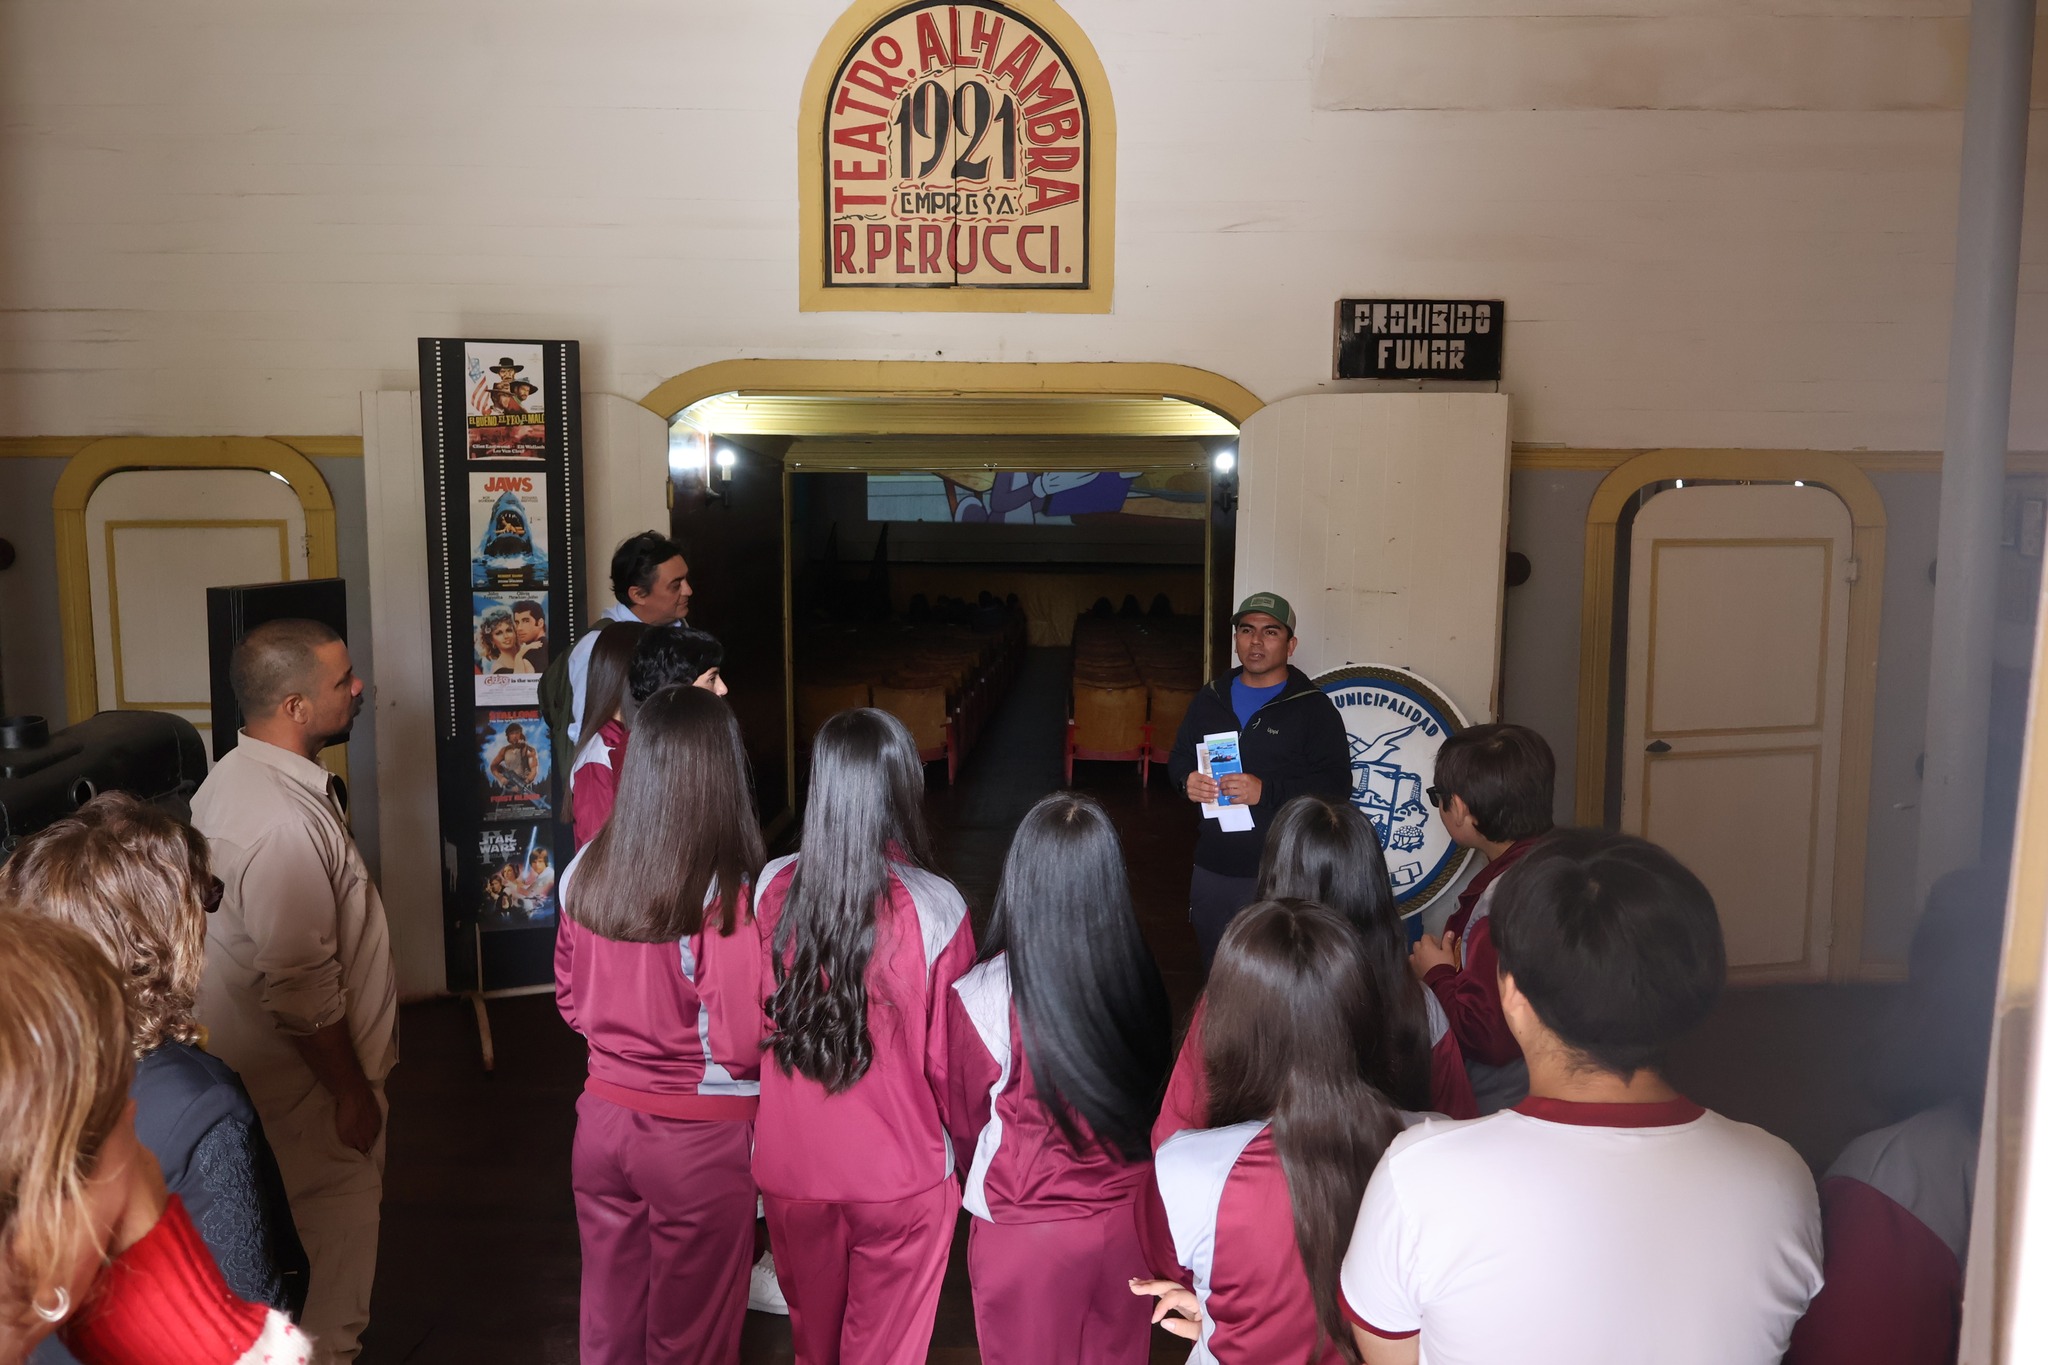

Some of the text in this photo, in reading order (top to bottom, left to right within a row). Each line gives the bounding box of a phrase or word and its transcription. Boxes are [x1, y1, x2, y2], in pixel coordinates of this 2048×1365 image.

[915, 6, 1081, 216] ALHAMBRA
[893, 80, 1018, 182] 1921
[1354, 303, 1491, 334] PROHIBIDO
[469, 416, 476, 425] EL
[499, 415, 506, 424] EL
[506, 414, 520, 426] FEO
[484, 477, 533, 492] JAWS
[488, 710, 539, 720] STALLONE
[1330, 692, 1439, 737] UNICIPALIDAD
[479, 834, 517, 846] STAR
[480, 842, 517, 854] WARS
